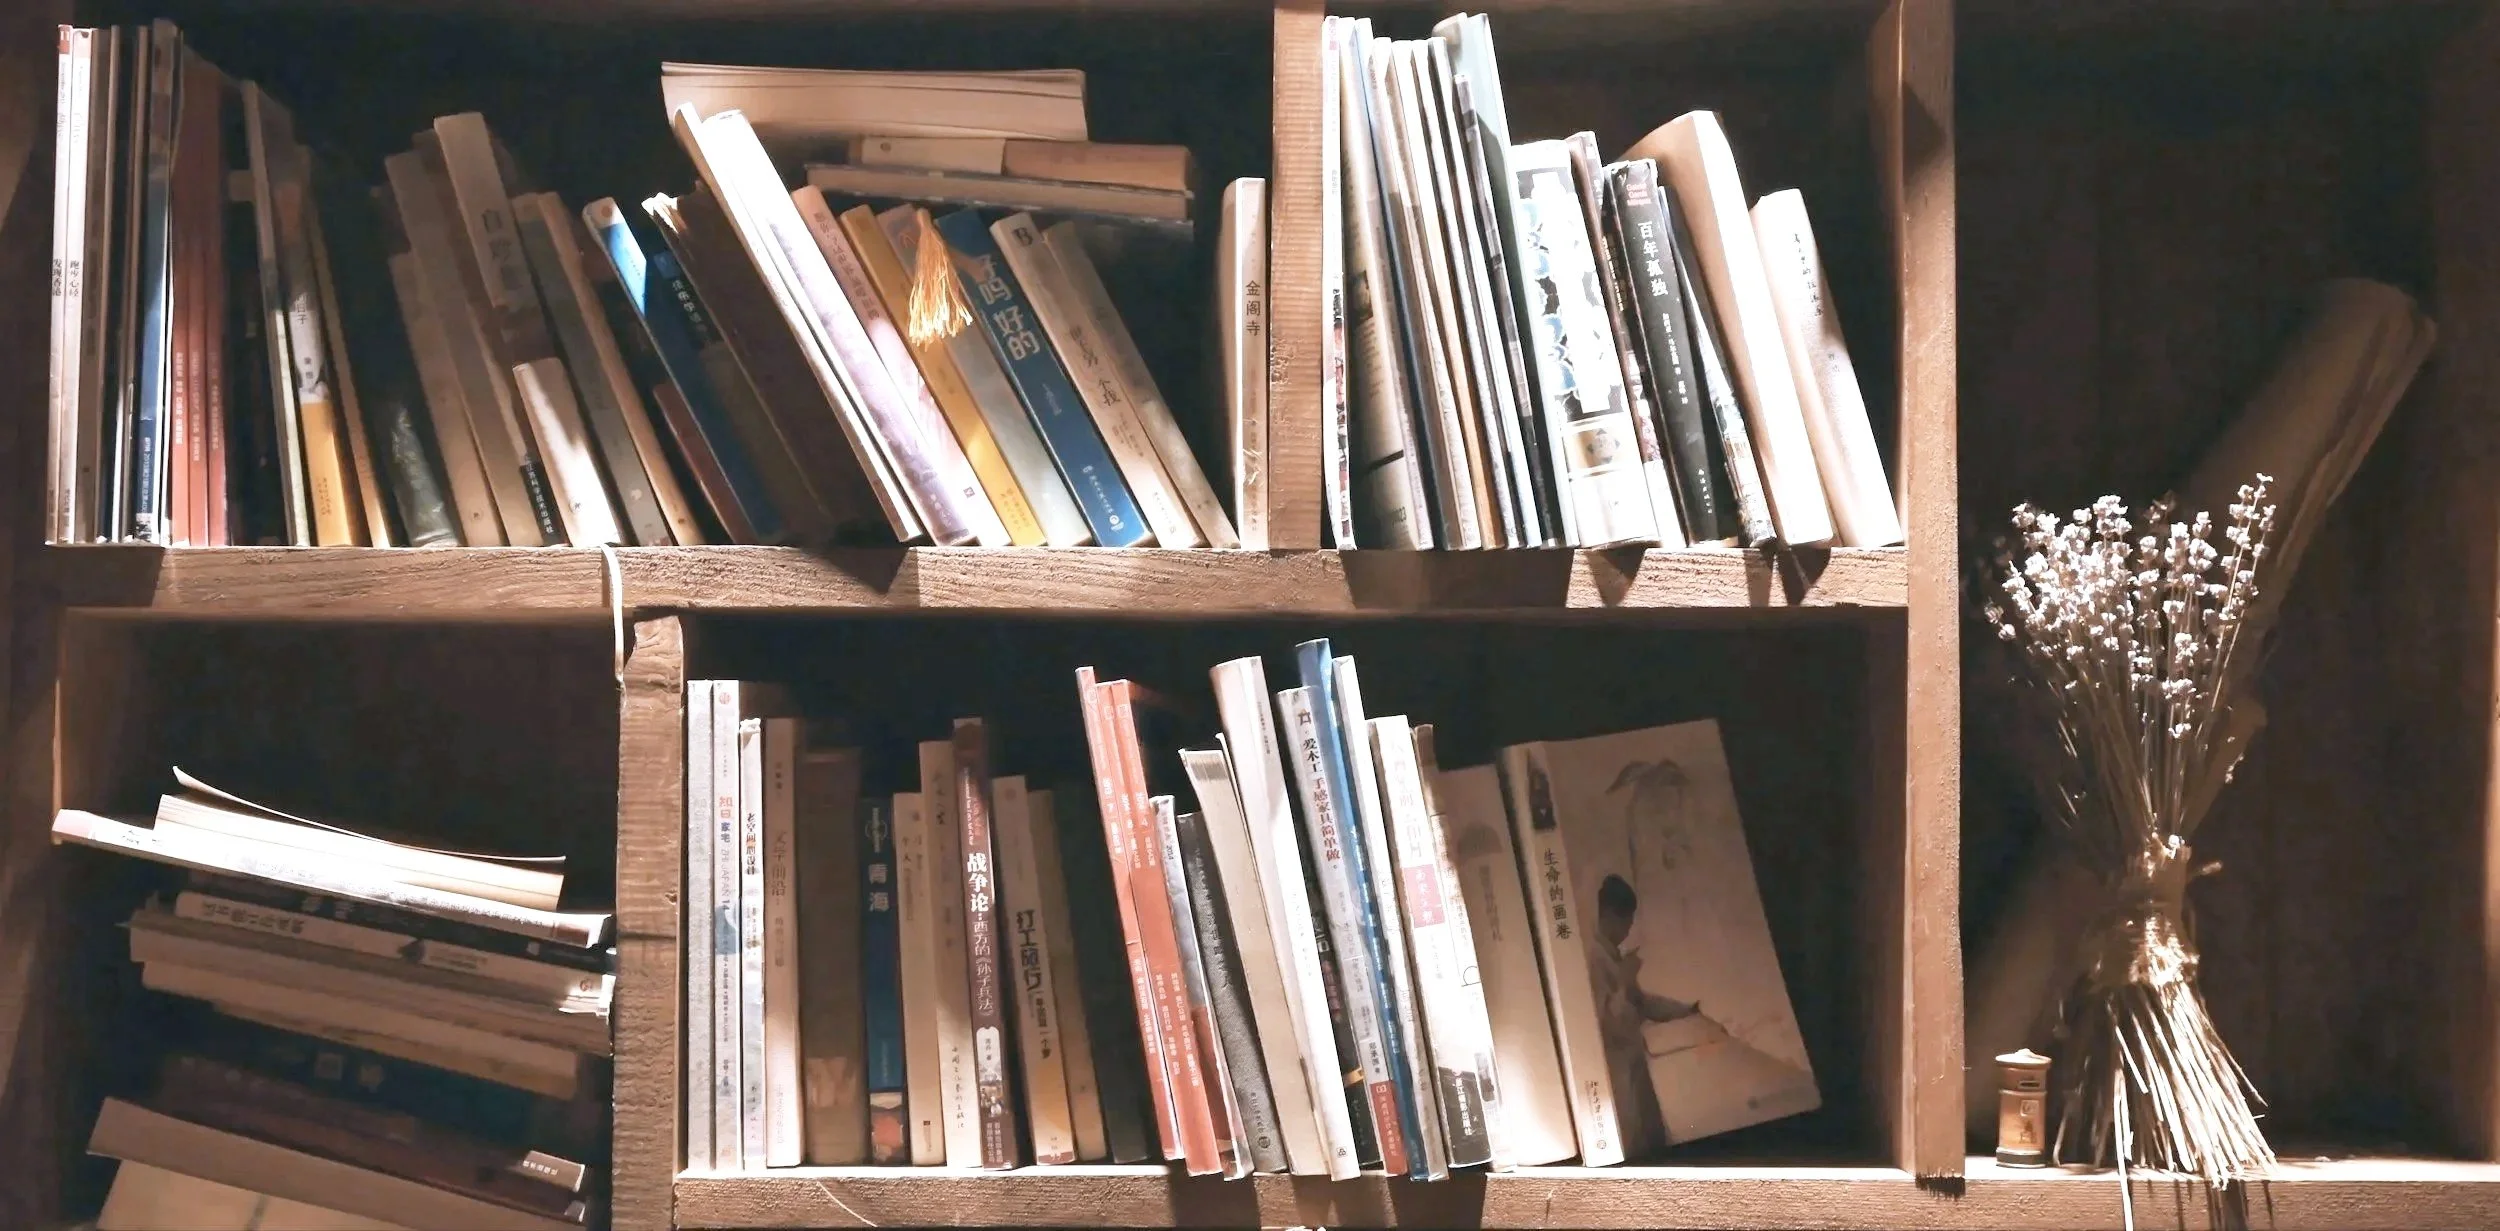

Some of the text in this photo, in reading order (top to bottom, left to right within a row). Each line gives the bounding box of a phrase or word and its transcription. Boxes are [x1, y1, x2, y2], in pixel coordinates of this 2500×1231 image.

[1638, 221, 1669, 297] 百年孤独
[1246, 280, 1261, 336] 金阁寺
[868, 864, 889, 912] 青海
[1543, 847, 1573, 940] 生命的画卷
